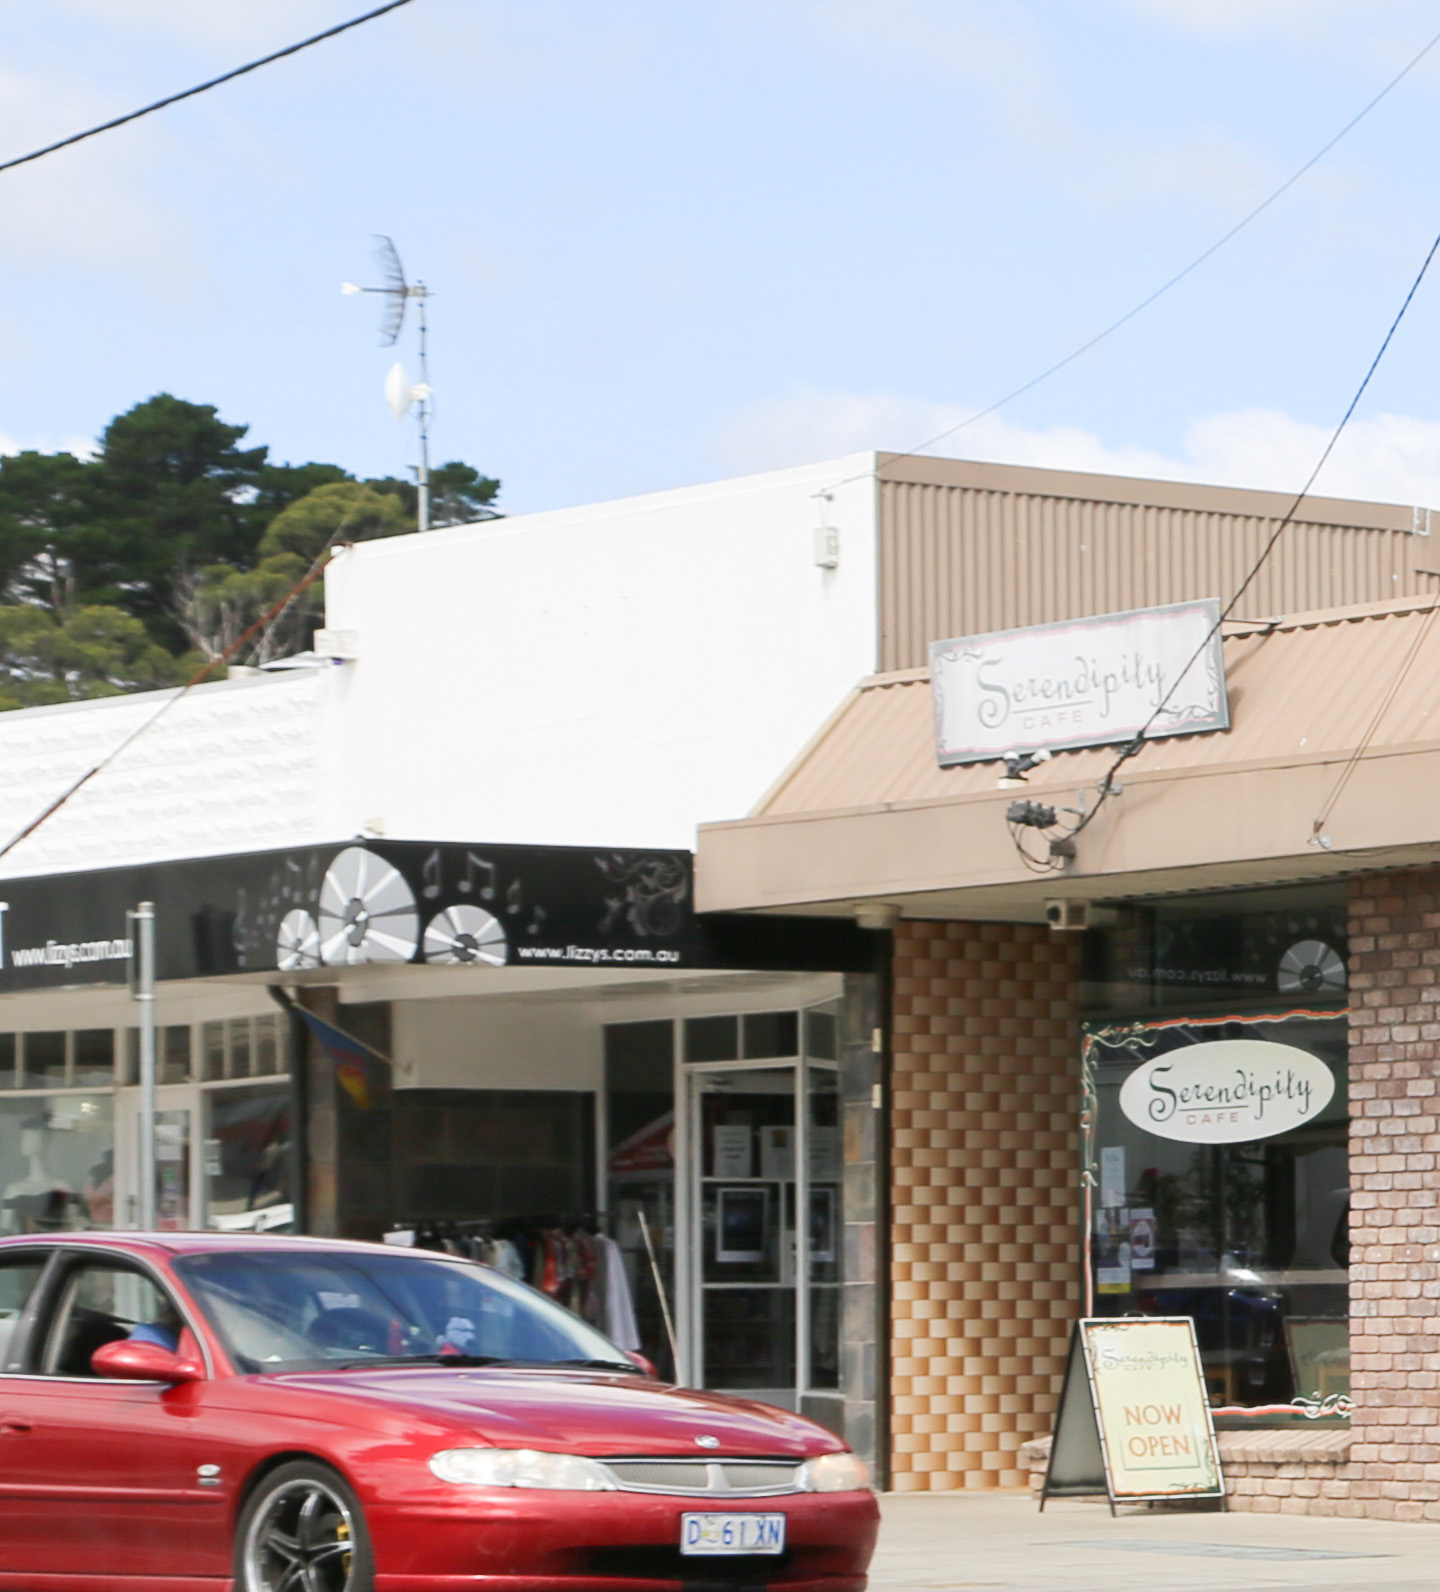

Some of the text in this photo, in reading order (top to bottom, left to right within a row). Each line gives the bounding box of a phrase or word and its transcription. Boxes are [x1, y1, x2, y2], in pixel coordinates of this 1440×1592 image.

[975, 651, 1166, 729] Serendipity
[1022, 710, 1084, 730] CAFE
[517, 945, 681, 963] www.lizzys.com.au
[1148, 1063, 1314, 1122] Serendipity
[1186, 1111, 1240, 1126] CAFE
[1124, 1404, 1182, 1426] NOW
[1128, 1434, 1191, 1458] OPEN
[688, 1520, 781, 1545] D 61 XN
